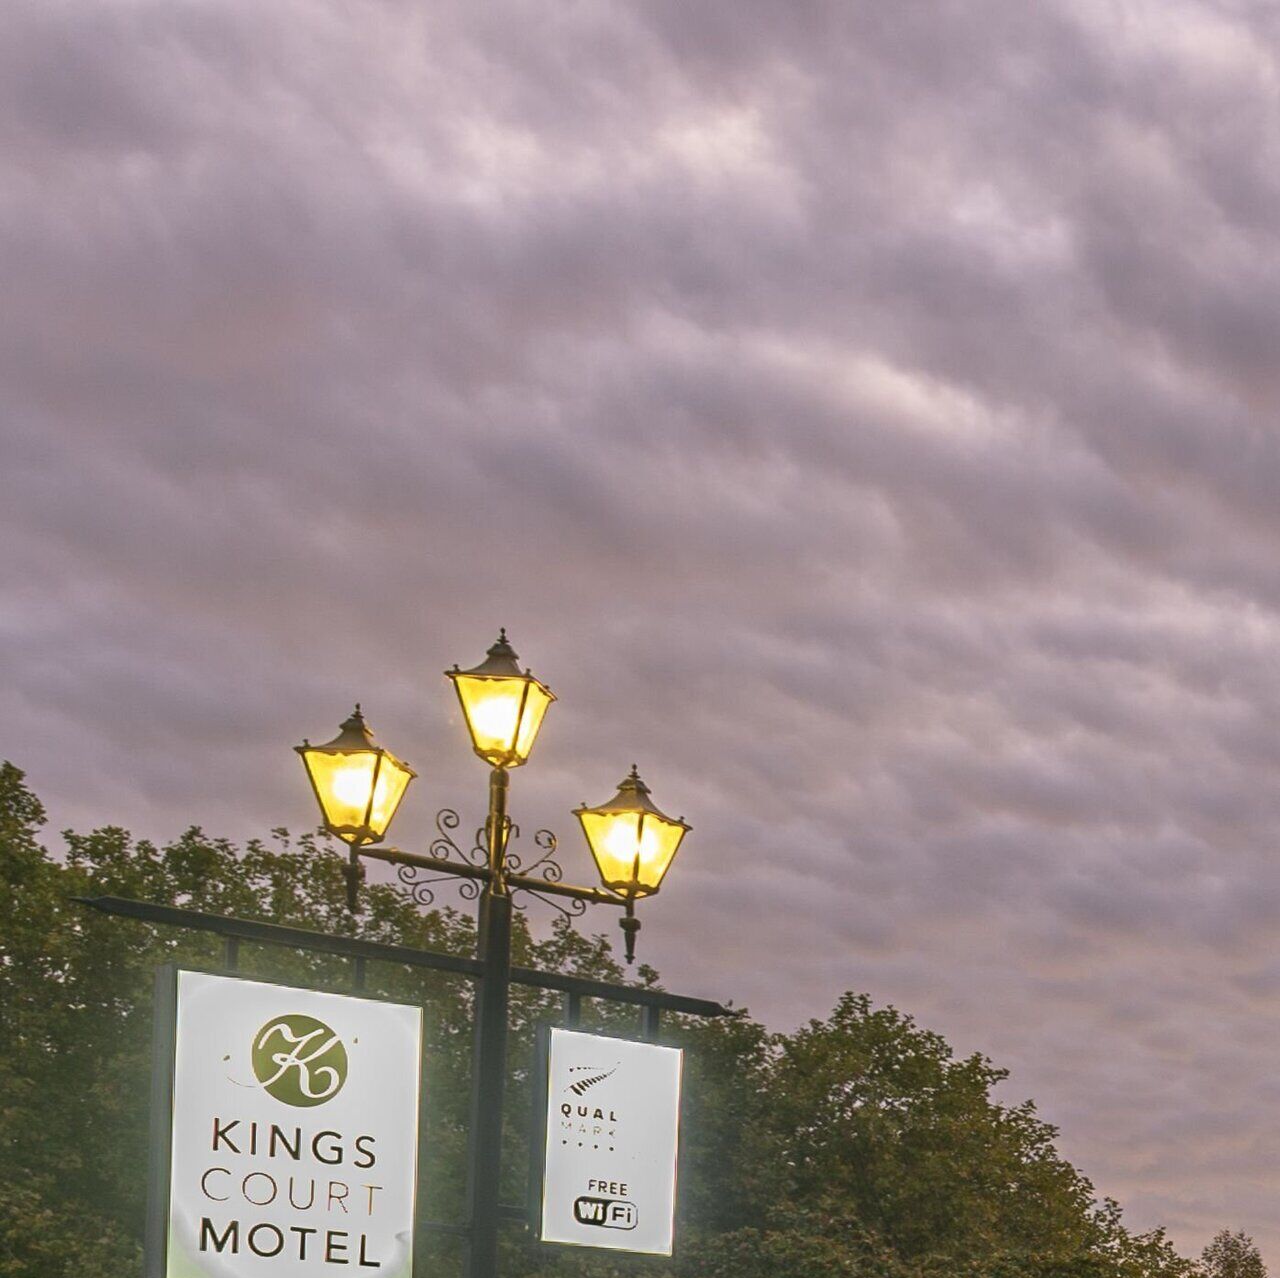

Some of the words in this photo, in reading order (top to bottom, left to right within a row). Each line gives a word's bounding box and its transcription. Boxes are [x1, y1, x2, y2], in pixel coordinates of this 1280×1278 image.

[560, 1103, 617, 1122] QUAL
[212, 1117, 376, 1169] KINGS
[200, 1167, 383, 1216] COURT
[588, 1179, 628, 1196] FREE
[199, 1216, 382, 1268] MOTEL
